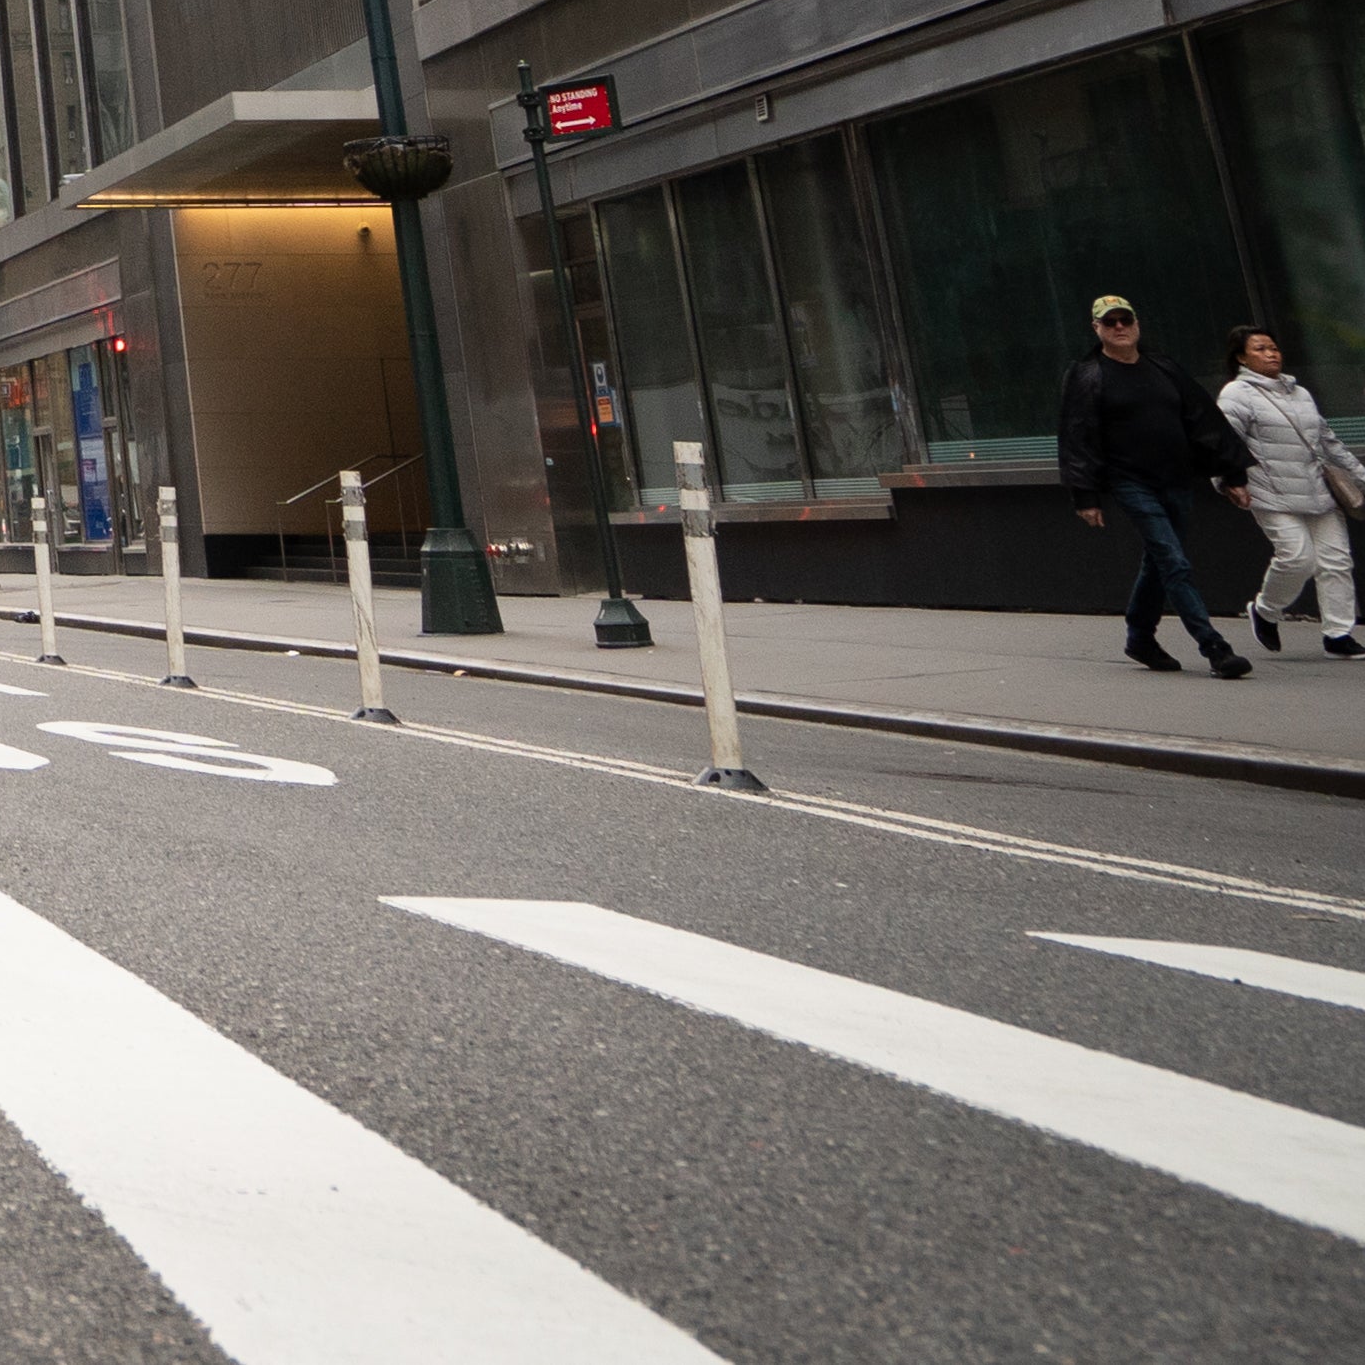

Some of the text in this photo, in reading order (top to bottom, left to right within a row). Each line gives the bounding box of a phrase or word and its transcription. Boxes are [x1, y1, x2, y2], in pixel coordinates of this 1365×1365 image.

[550, 87, 598, 104] NO STANDING
[552, 102, 583, 115] Anytime
[203, 262, 263, 290] 277
